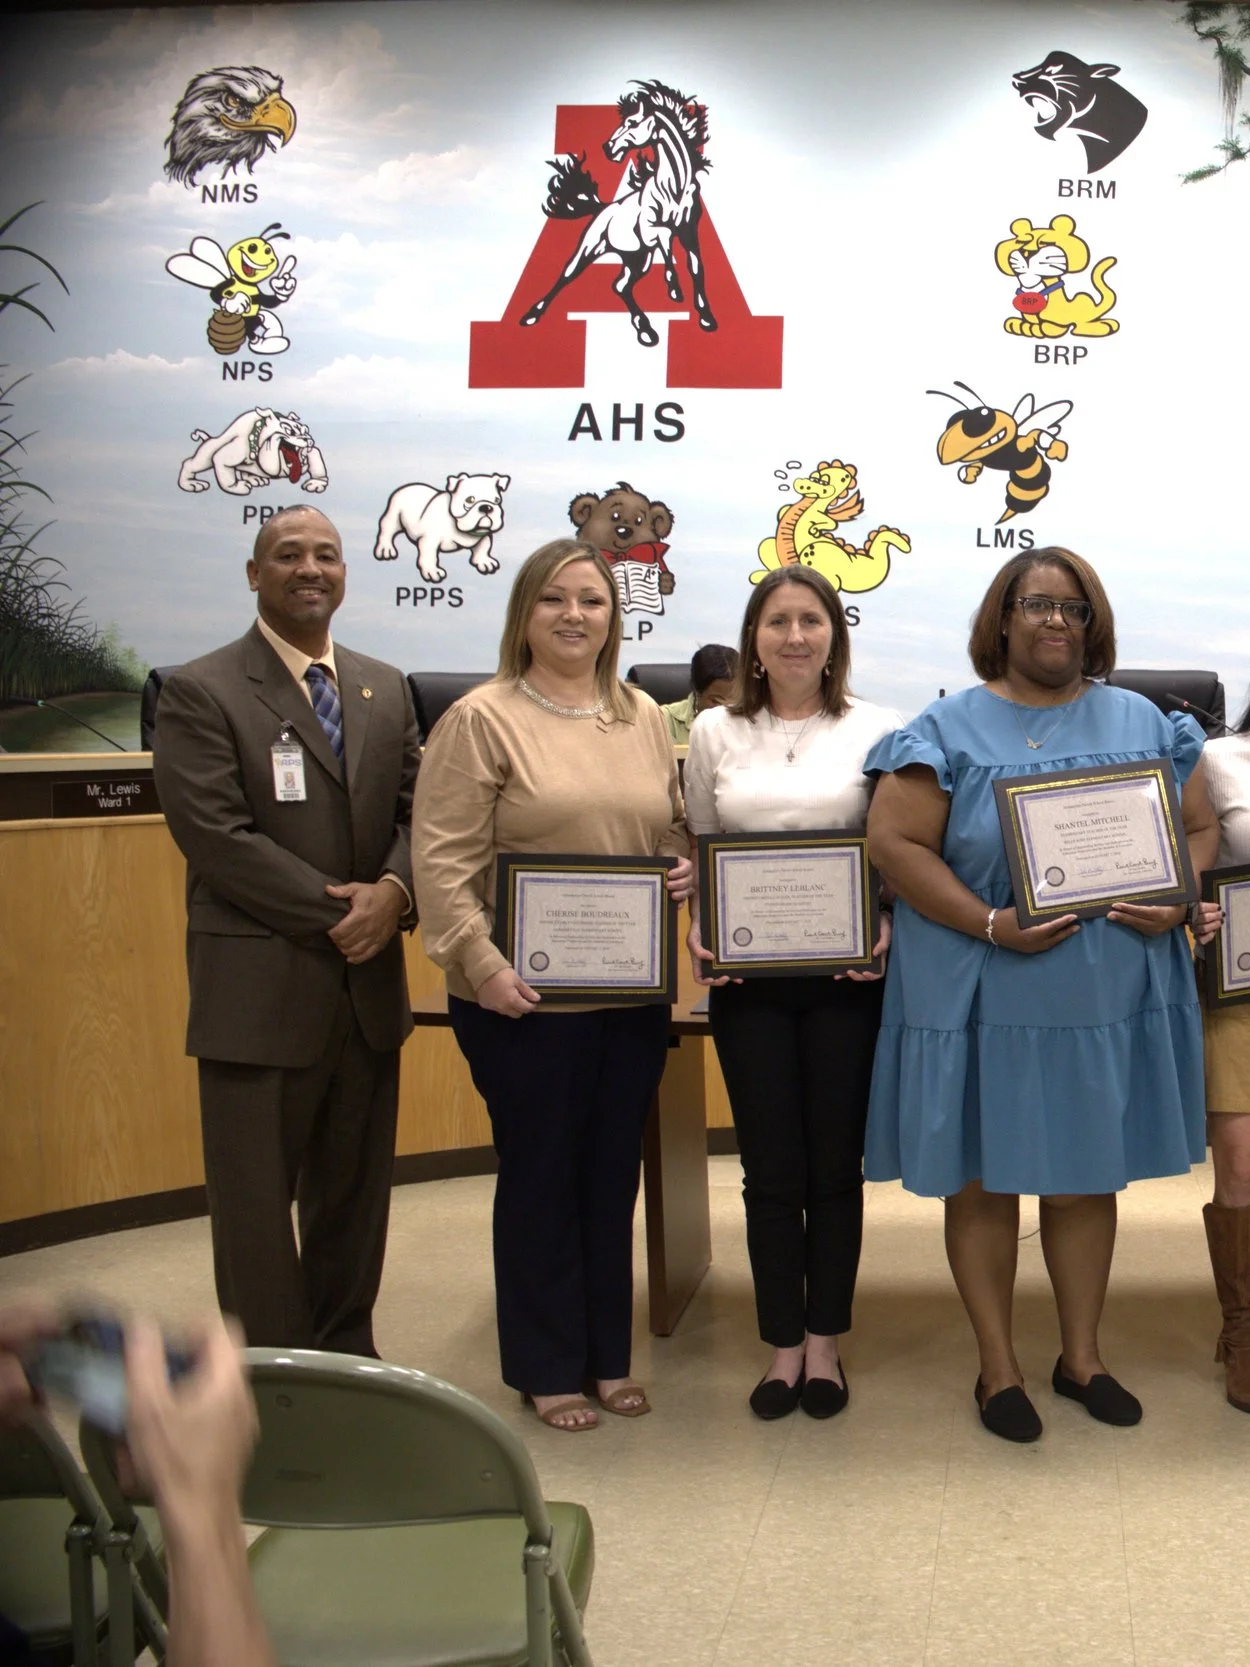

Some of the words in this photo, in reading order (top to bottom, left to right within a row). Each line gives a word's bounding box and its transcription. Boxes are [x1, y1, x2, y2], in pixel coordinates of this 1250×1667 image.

[201, 183, 259, 204] NMS
[1058, 178, 1117, 199] BRM
[1034, 344, 1088, 365] BRP
[222, 361, 274, 382] NPS
[568, 402, 685, 442] AHS
[243, 505, 284, 525] PP
[976, 527, 1035, 549] LMS
[396, 587, 464, 608] PPPS
[86, 784, 105, 796] Mr.
[110, 782, 141, 795] Lewis
[98, 798, 122, 808] Ward
[126, 796, 131, 806] 1
